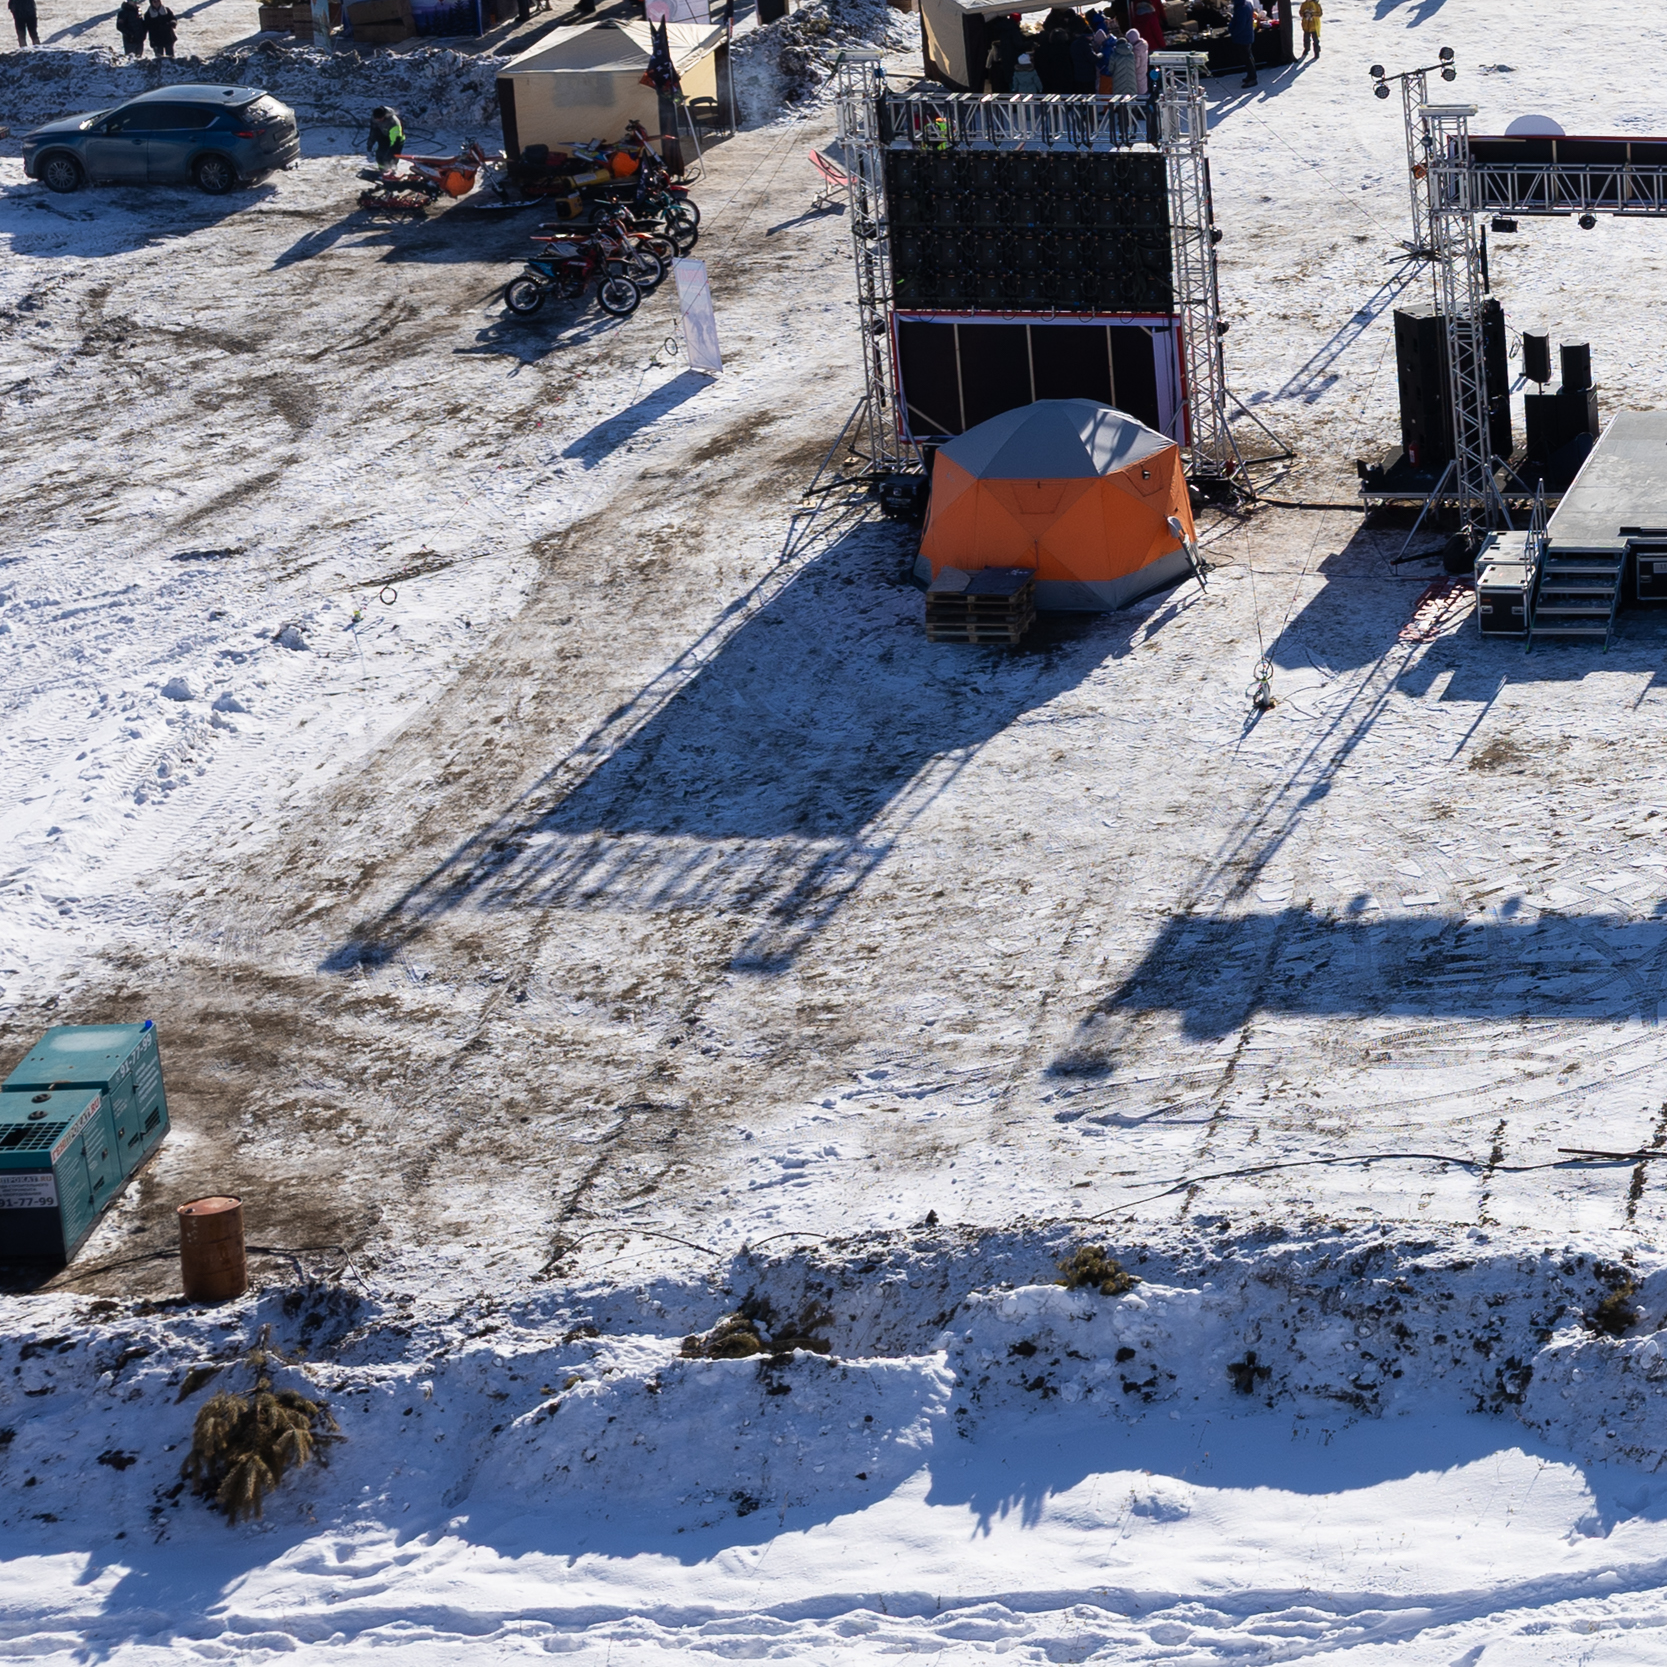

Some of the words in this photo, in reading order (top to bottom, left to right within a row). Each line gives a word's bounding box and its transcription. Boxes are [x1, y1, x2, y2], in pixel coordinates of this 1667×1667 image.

[119, 1032, 153, 1079] 91-77-99
[0, 1175, 52, 1185] ПРОКАТ.RU
[0, 1196, 54, 1208] 91-77-99
